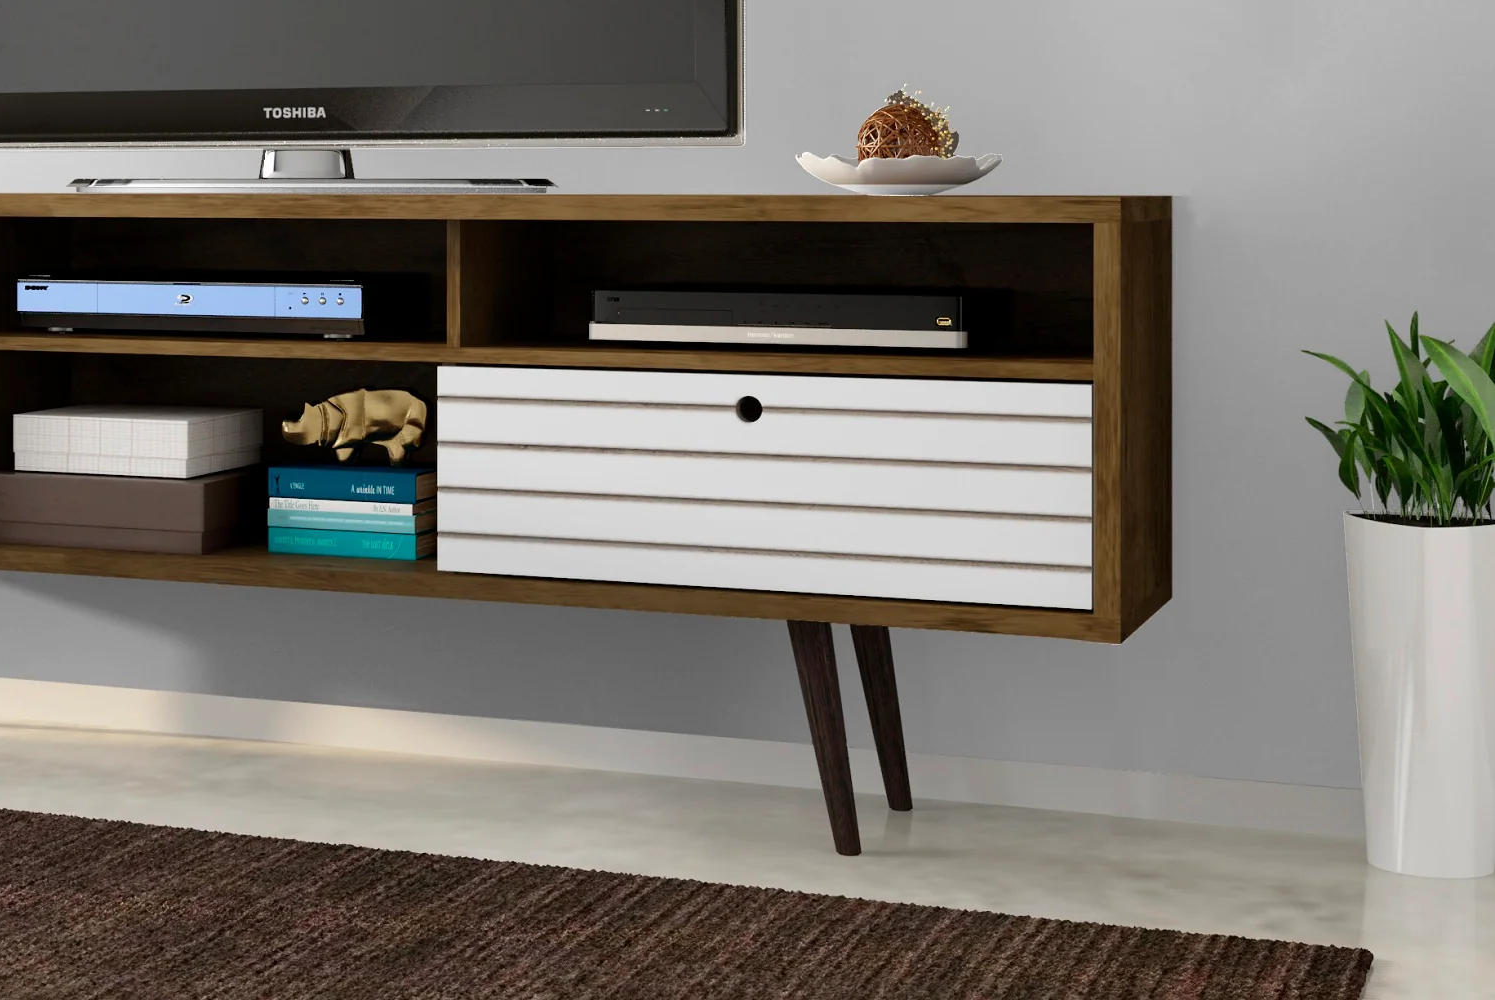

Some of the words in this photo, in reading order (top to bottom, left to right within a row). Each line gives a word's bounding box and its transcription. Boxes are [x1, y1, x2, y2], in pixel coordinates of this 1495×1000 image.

[263, 106, 326, 118] TOSHIBA
[383, 486, 395, 496] TIME
[274, 500, 284, 508] The
[284, 500, 294, 509] Title
[308, 501, 320, 510] Here
